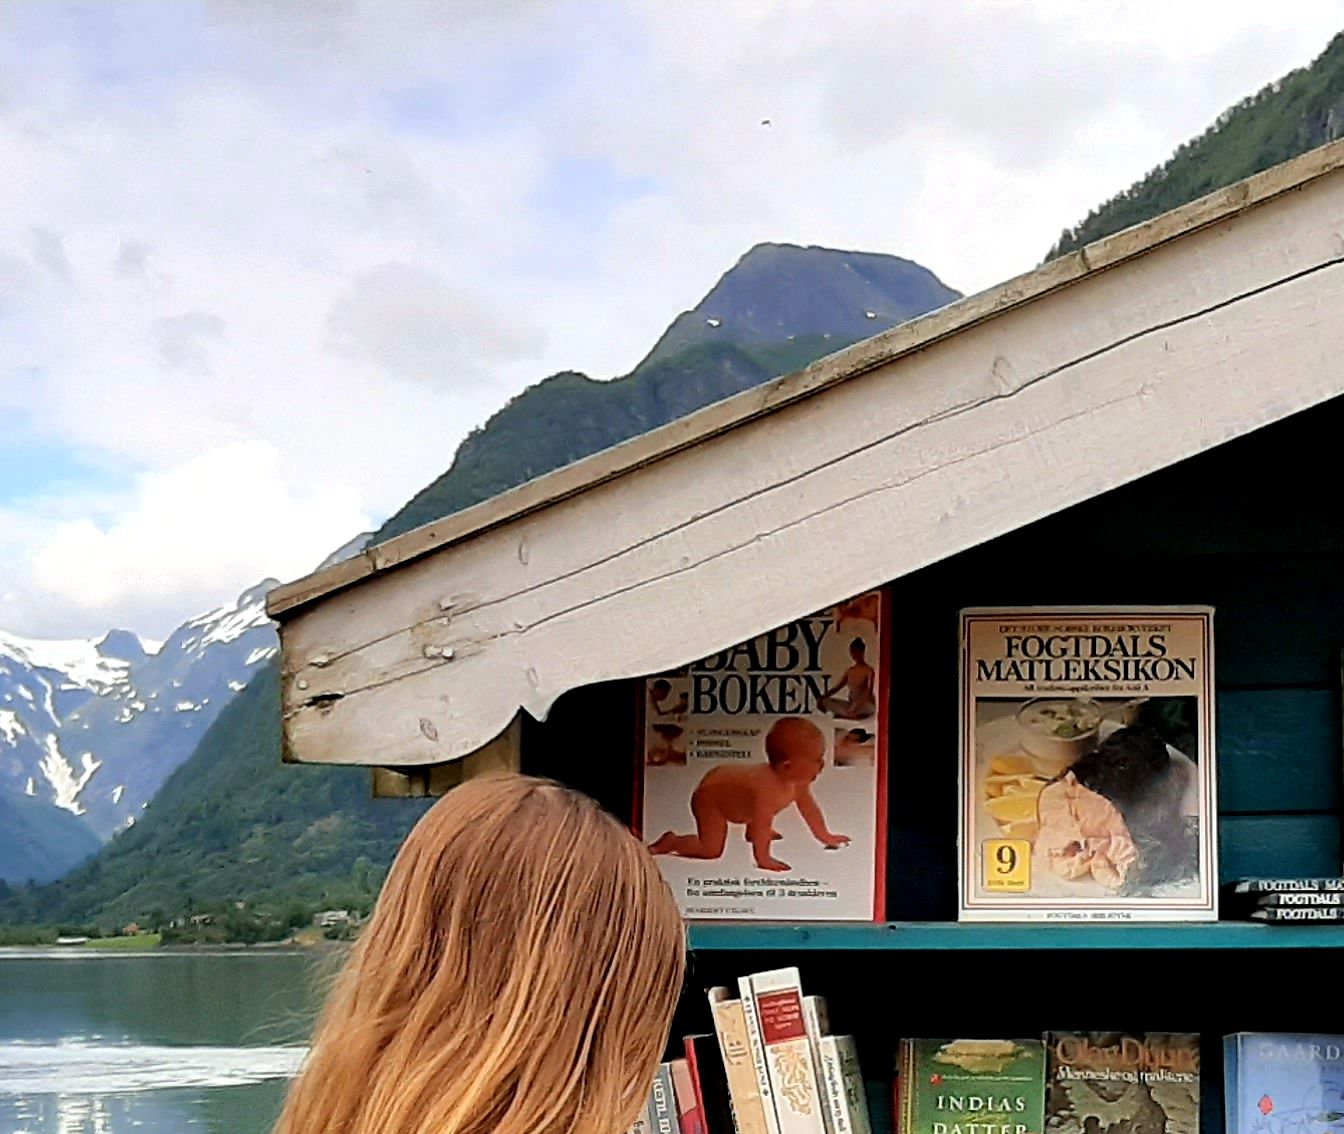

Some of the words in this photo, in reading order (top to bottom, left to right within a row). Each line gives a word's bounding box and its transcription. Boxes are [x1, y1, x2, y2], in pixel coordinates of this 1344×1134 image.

[1005, 635, 1167, 659] FOGTDALS
[976, 657, 1197, 682] MATLEKSIKON
[691, 674, 831, 714] BOKEN
[996, 845, 1017, 874] 9
[1258, 880, 1318, 891] FOGTDALS
[1279, 893, 1340, 905] FOGTDALS
[1276, 906, 1337, 918] FOGTDALS
[937, 1095, 1025, 1112] INDIAS
